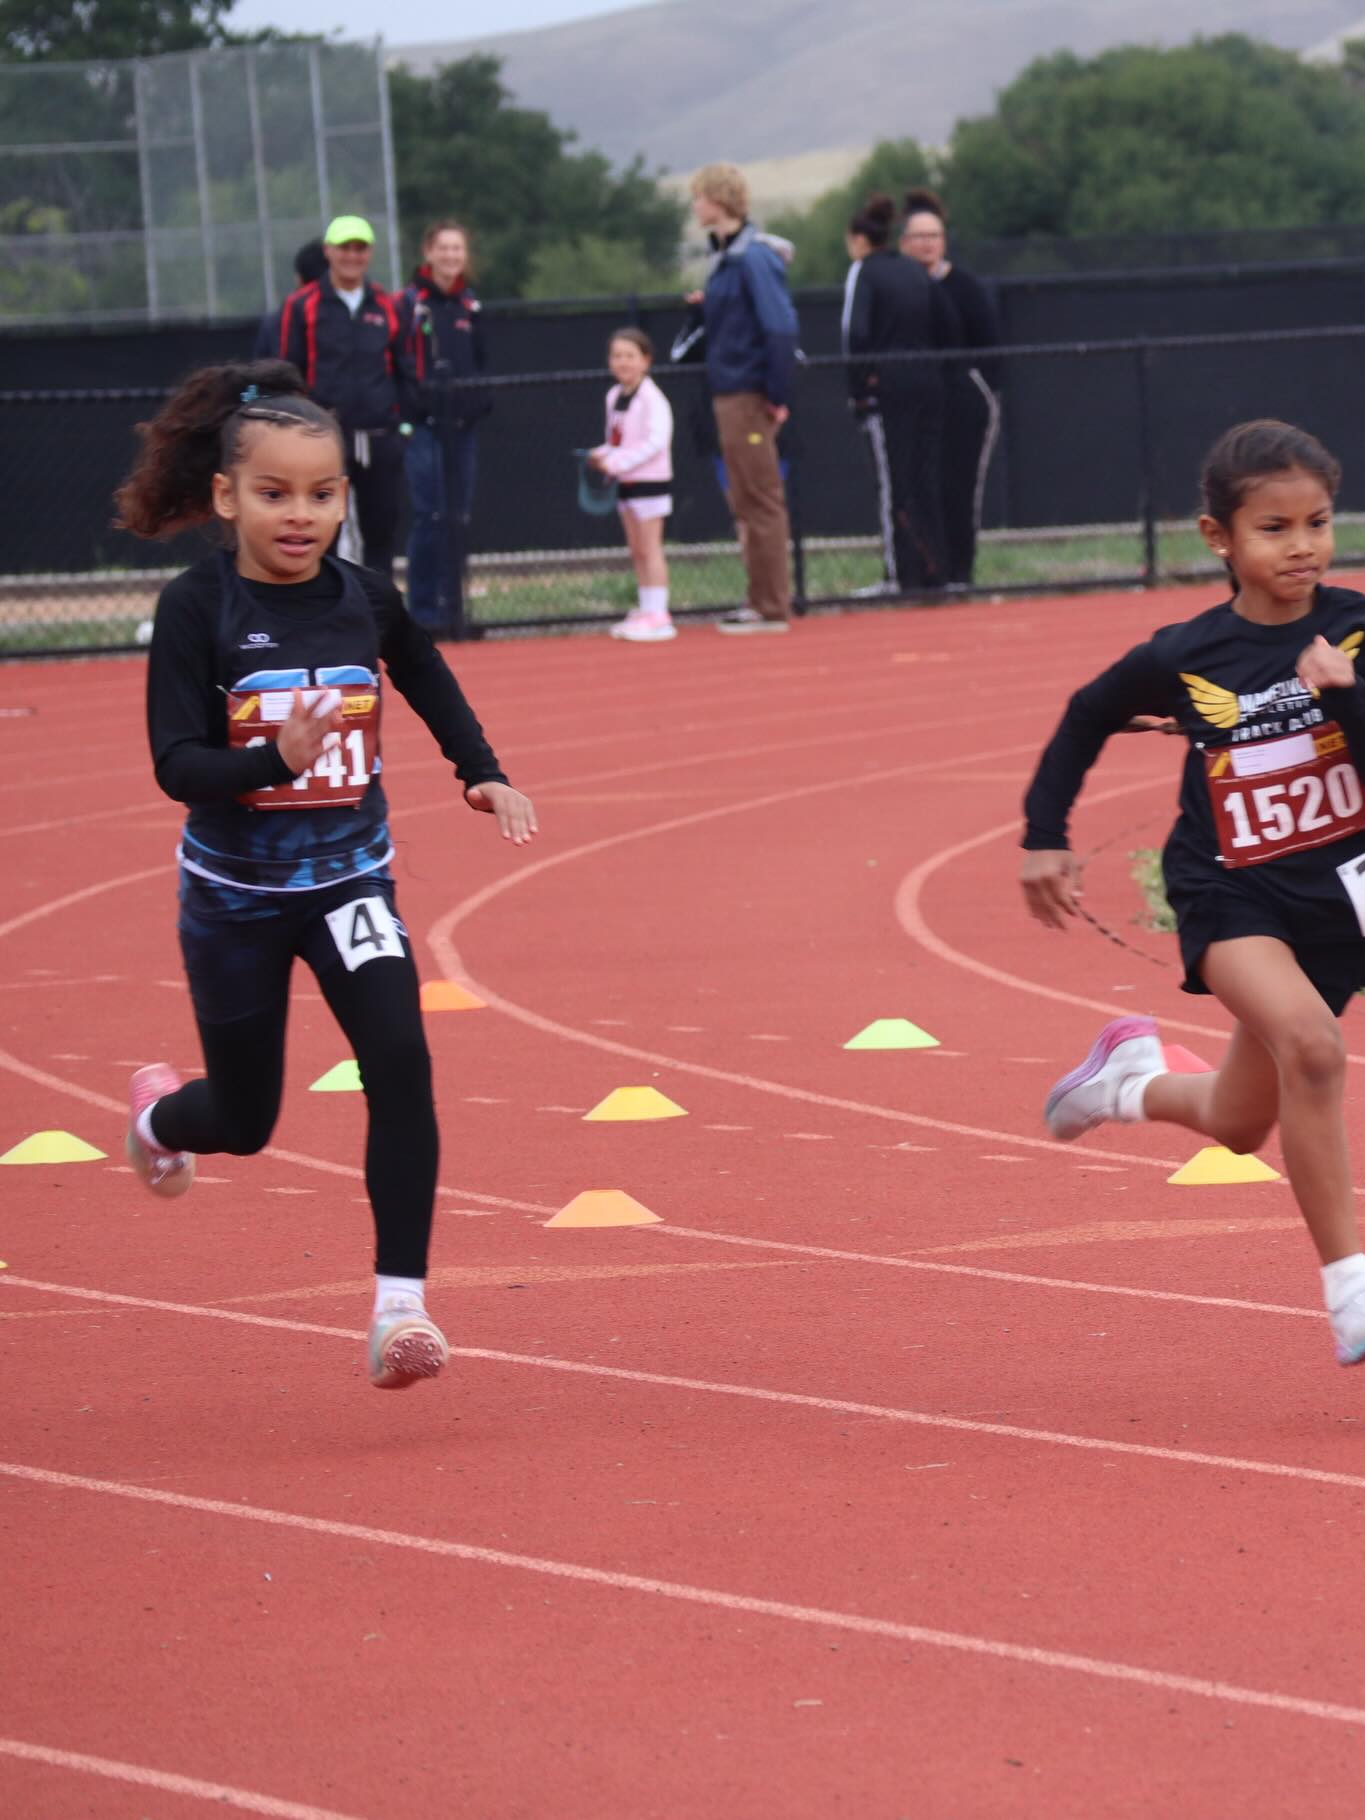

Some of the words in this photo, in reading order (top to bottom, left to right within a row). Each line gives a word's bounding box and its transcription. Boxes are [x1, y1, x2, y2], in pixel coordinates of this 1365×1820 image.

[245, 729, 371, 791] 41
[1224, 763, 1364, 848] 1520
[350, 903, 386, 951] 4
